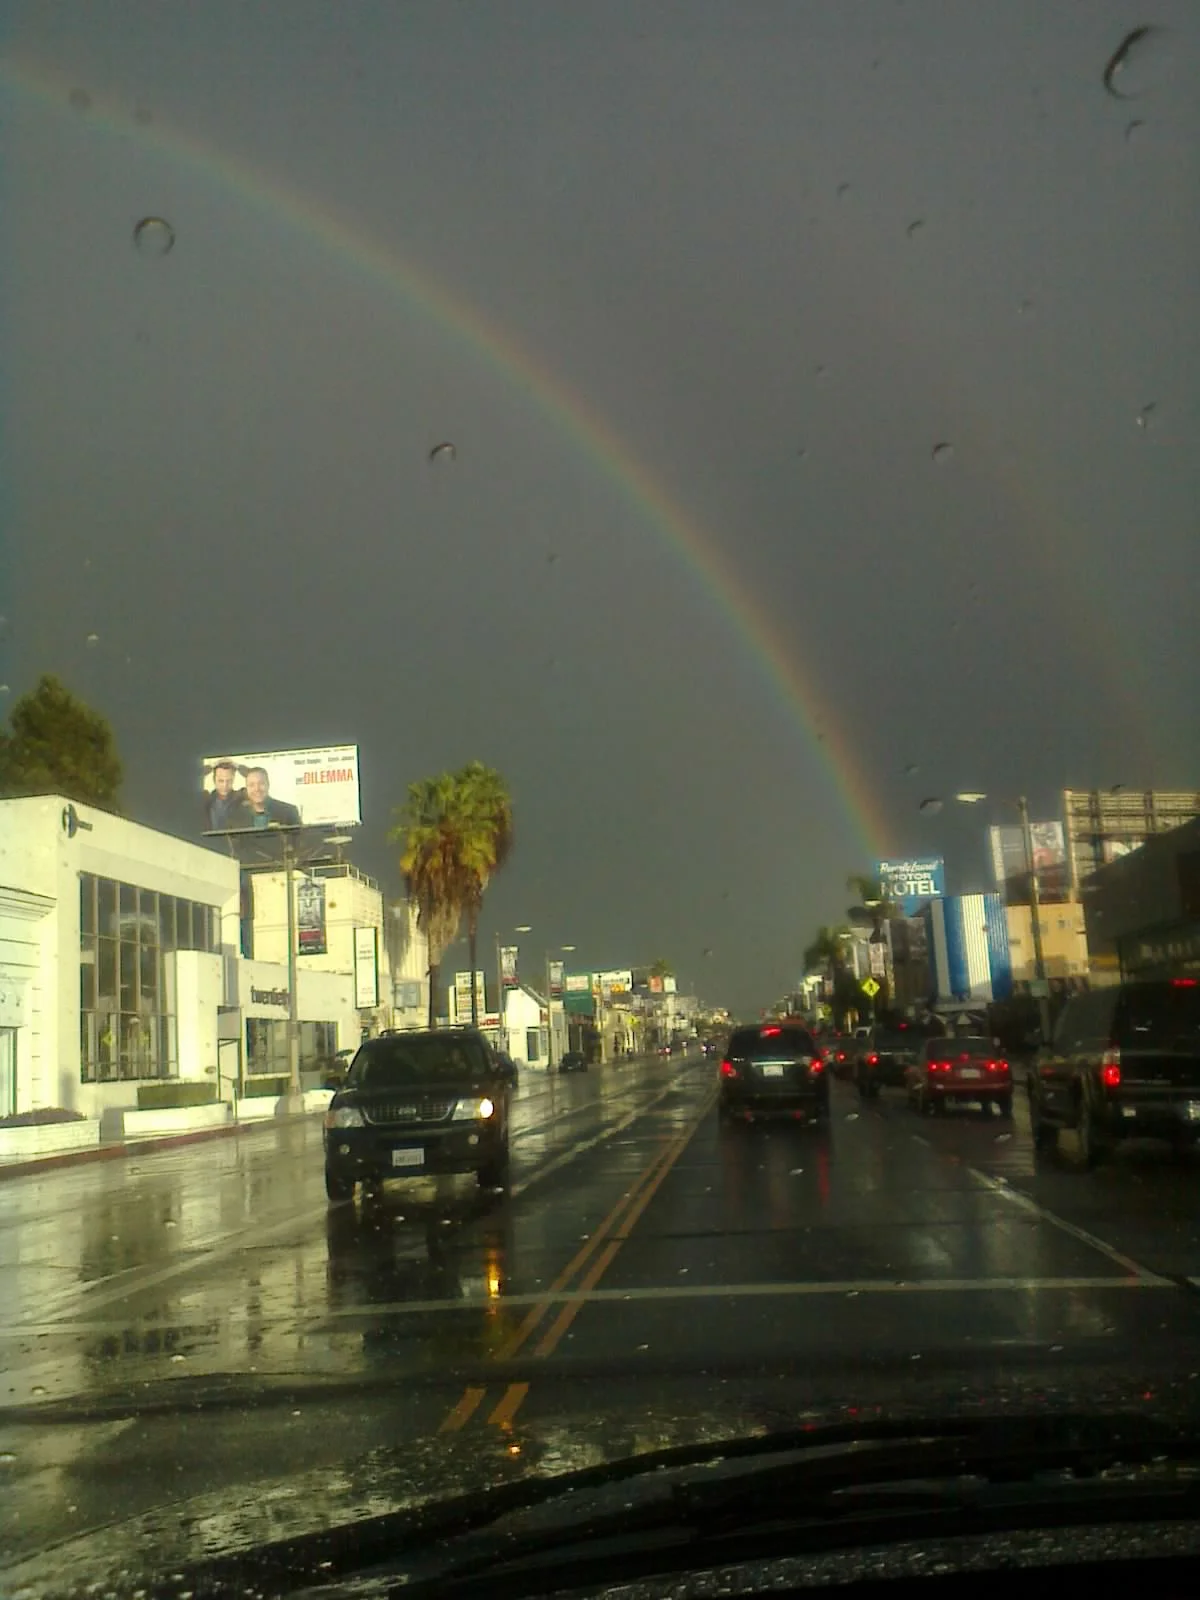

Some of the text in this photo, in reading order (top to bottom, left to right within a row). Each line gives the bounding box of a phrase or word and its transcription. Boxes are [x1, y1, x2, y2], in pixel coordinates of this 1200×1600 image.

[303, 768, 354, 785] DILEMMA
[888, 872, 932, 881] MOTOR
[880, 879, 941, 897] HOTEL
